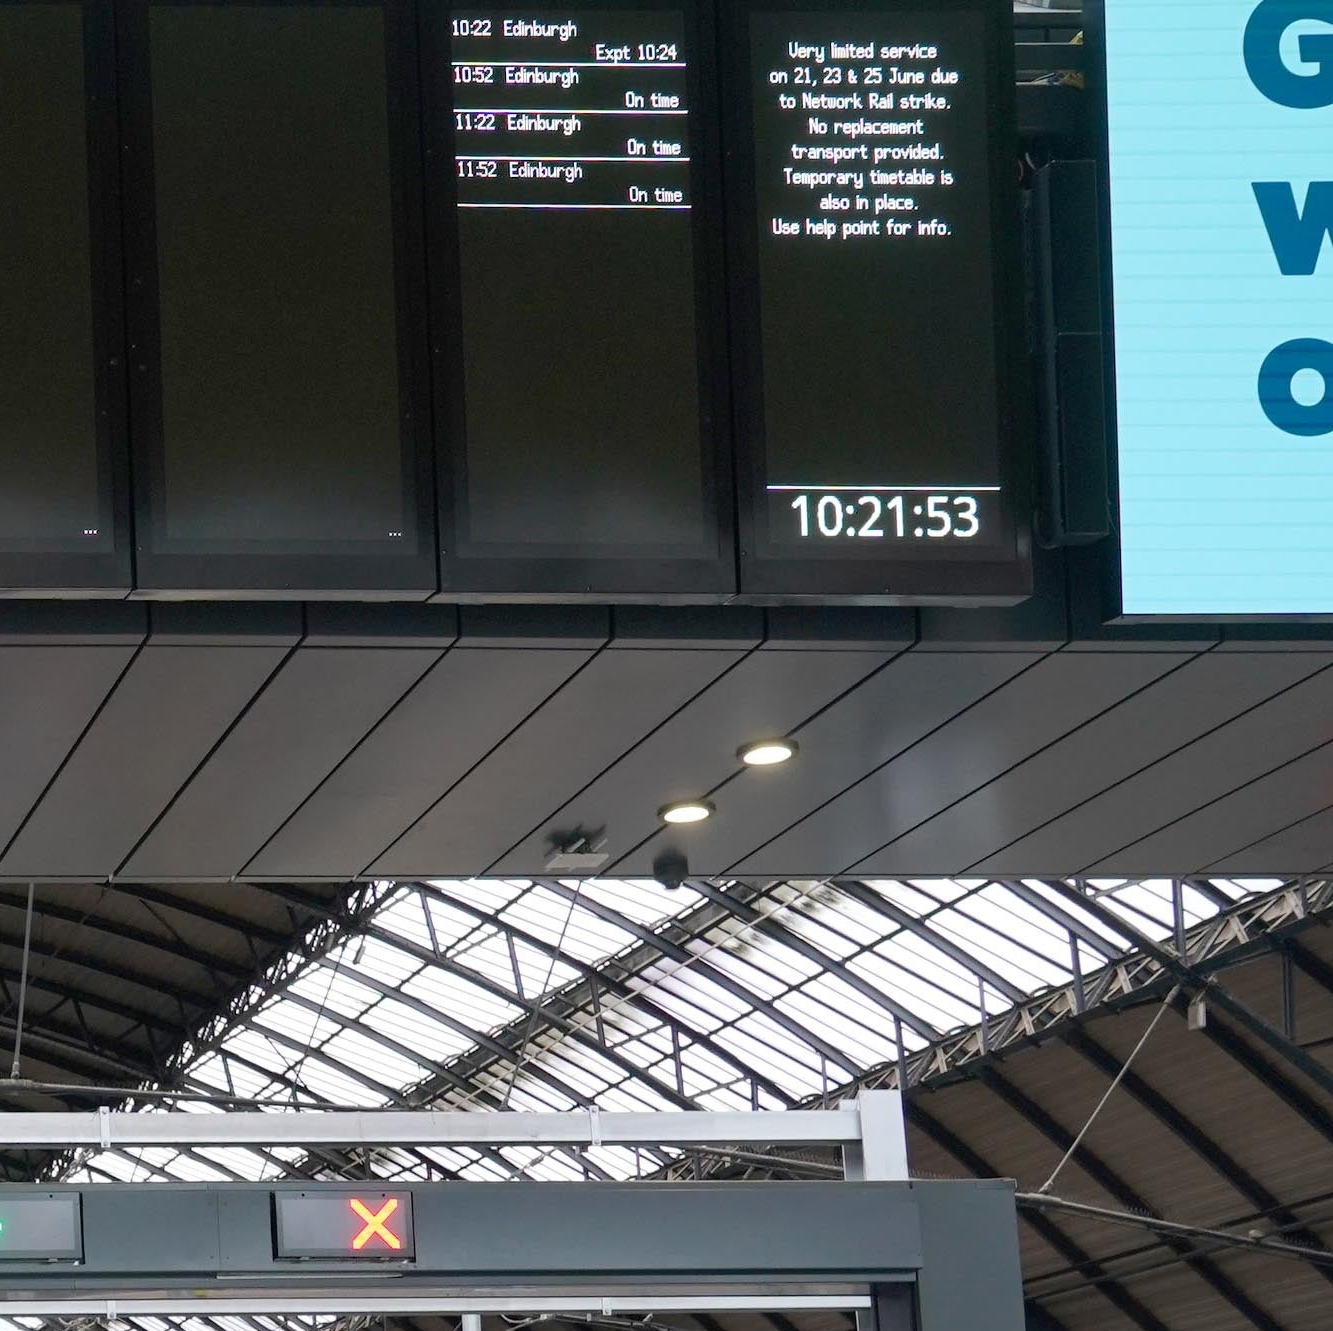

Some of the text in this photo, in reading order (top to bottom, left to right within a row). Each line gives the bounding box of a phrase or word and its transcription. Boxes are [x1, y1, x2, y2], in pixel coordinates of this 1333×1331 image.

[452, 19, 577, 42] 10:22 Edinburgh
[595, 43, 678, 64] Expt 10:24
[788, 41, 938, 64] Very limited service
[454, 66, 579, 89] 10:52 Edinburgh
[769, 66, 959, 87] on 21, 23 & 25 June due
[625, 90, 680, 108] On time
[778, 92, 951, 110] to Network Rail strike.
[455, 113, 582, 136] 11:22 Edinburgh
[808, 117, 924, 139] No replacement
[627, 137, 682, 156] On time
[790, 142, 945, 165] transport provided.
[457, 160, 583, 183] 11:52 Edinburgh
[783, 167, 954, 190] Temporary timetable is
[629, 185, 683, 203] On time
[819, 192, 919, 215] also in place.
[772, 217, 952, 240] Use help point for info.
[791, 494, 979, 538] 10:21:53
